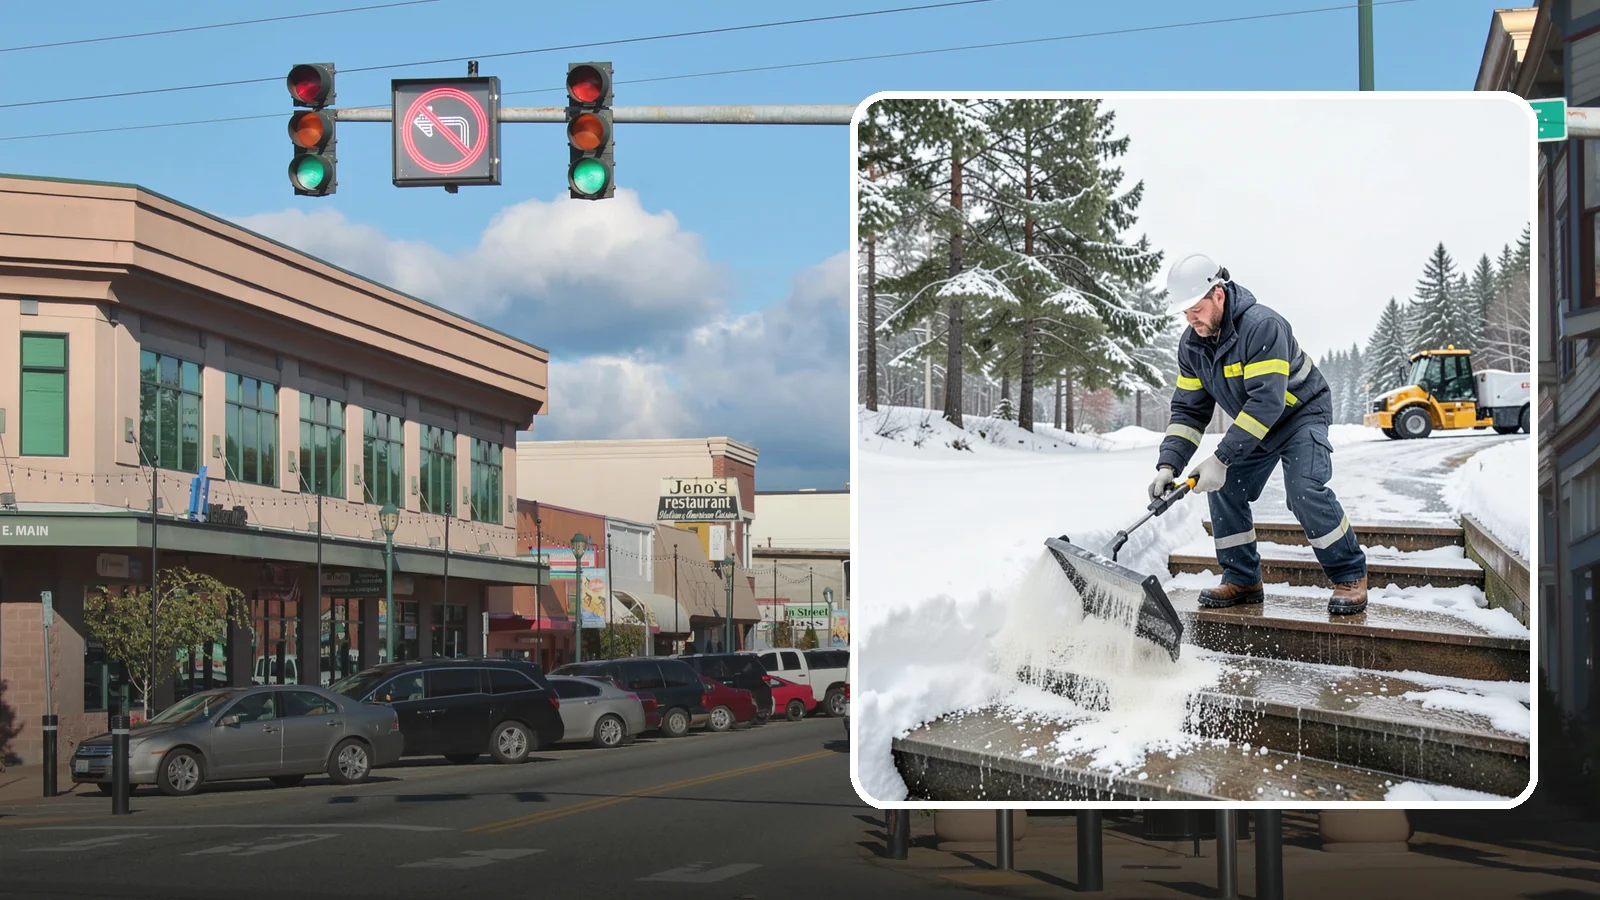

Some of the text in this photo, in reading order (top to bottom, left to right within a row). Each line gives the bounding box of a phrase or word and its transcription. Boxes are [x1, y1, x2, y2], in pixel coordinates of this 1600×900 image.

[669, 480, 727, 494] Jeno's
[665, 496, 731, 509] restaurant
[658, 510, 681, 519] Italian
[686, 510, 714, 519] American
[714, 510, 737, 519] Cuisine
[2, 525, 49, 536] E. MAIN
[785, 607, 795, 617] in
[797, 608, 828, 616] Street
[790, 619, 824, 627] lass
